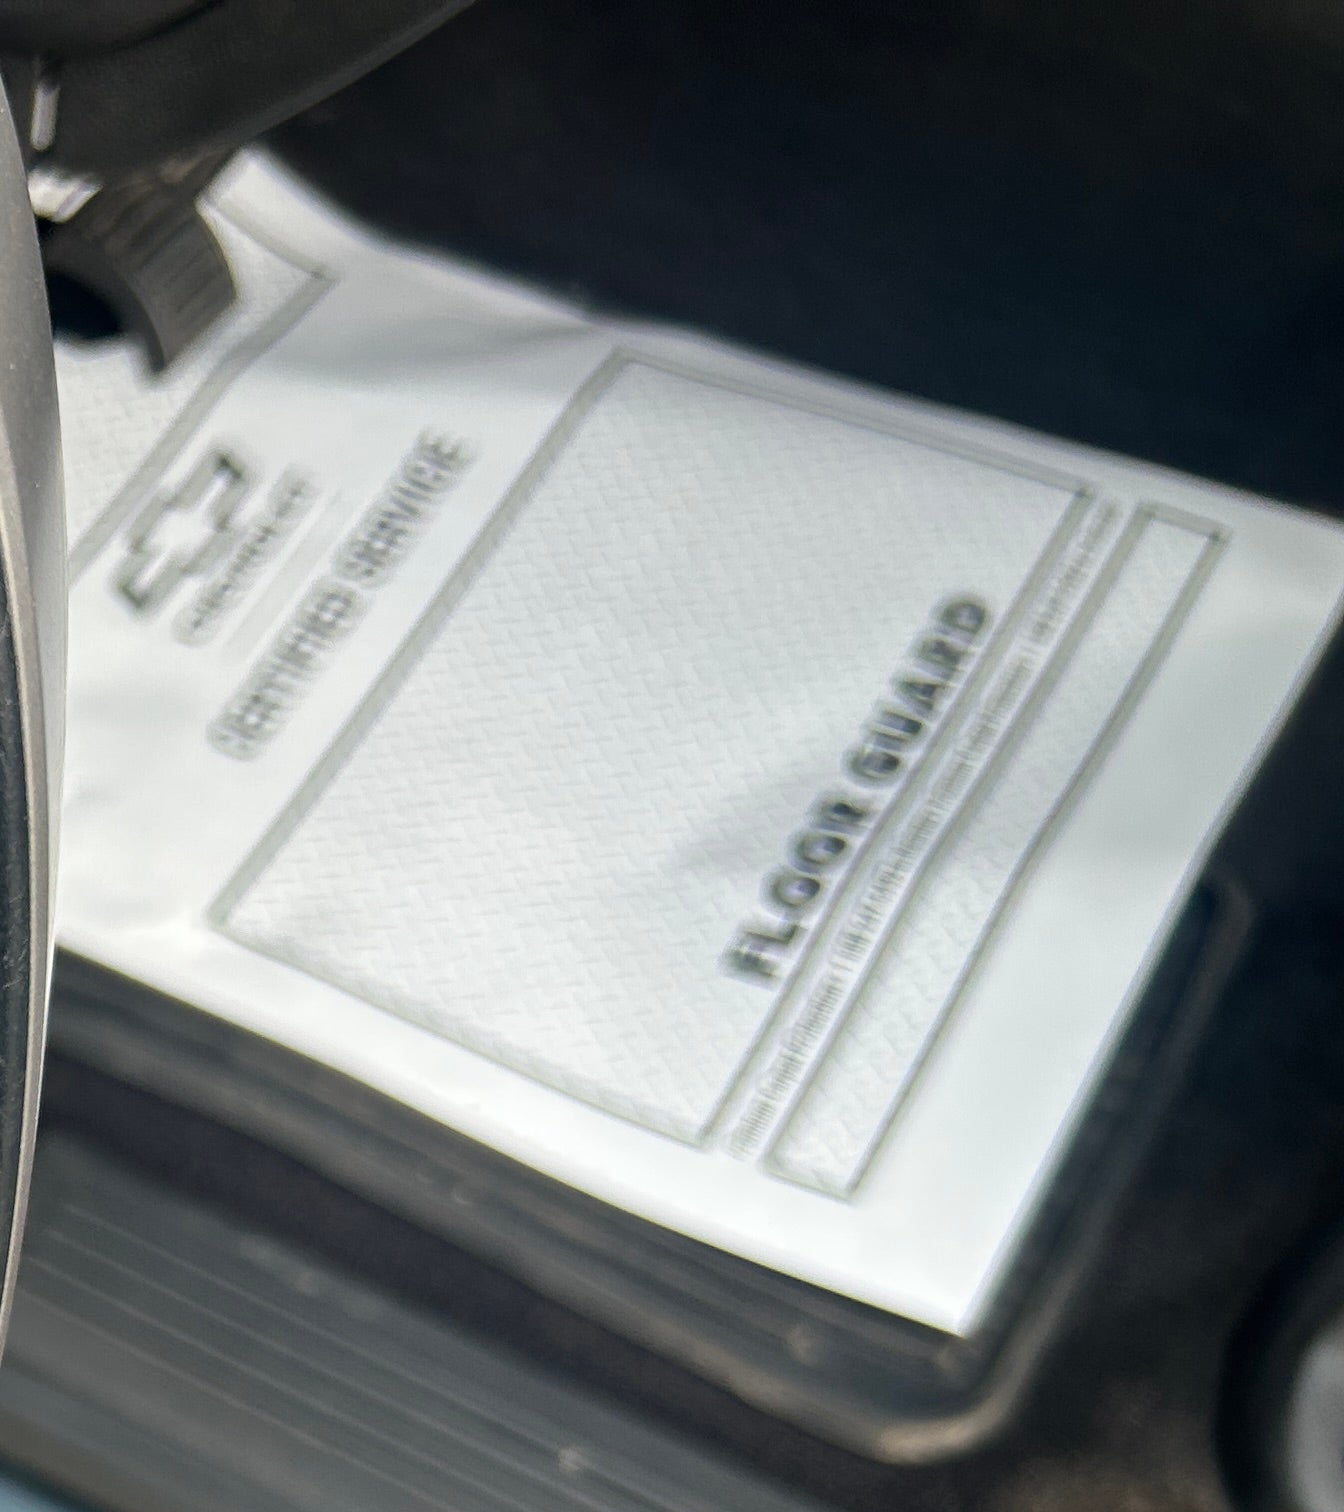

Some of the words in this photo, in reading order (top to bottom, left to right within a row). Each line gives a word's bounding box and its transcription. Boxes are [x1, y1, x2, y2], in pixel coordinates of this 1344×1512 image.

[334, 429, 476, 588] SERVICE
[723, 796, 872, 984] FLOOR
[843, 595, 988, 786] GUARD
